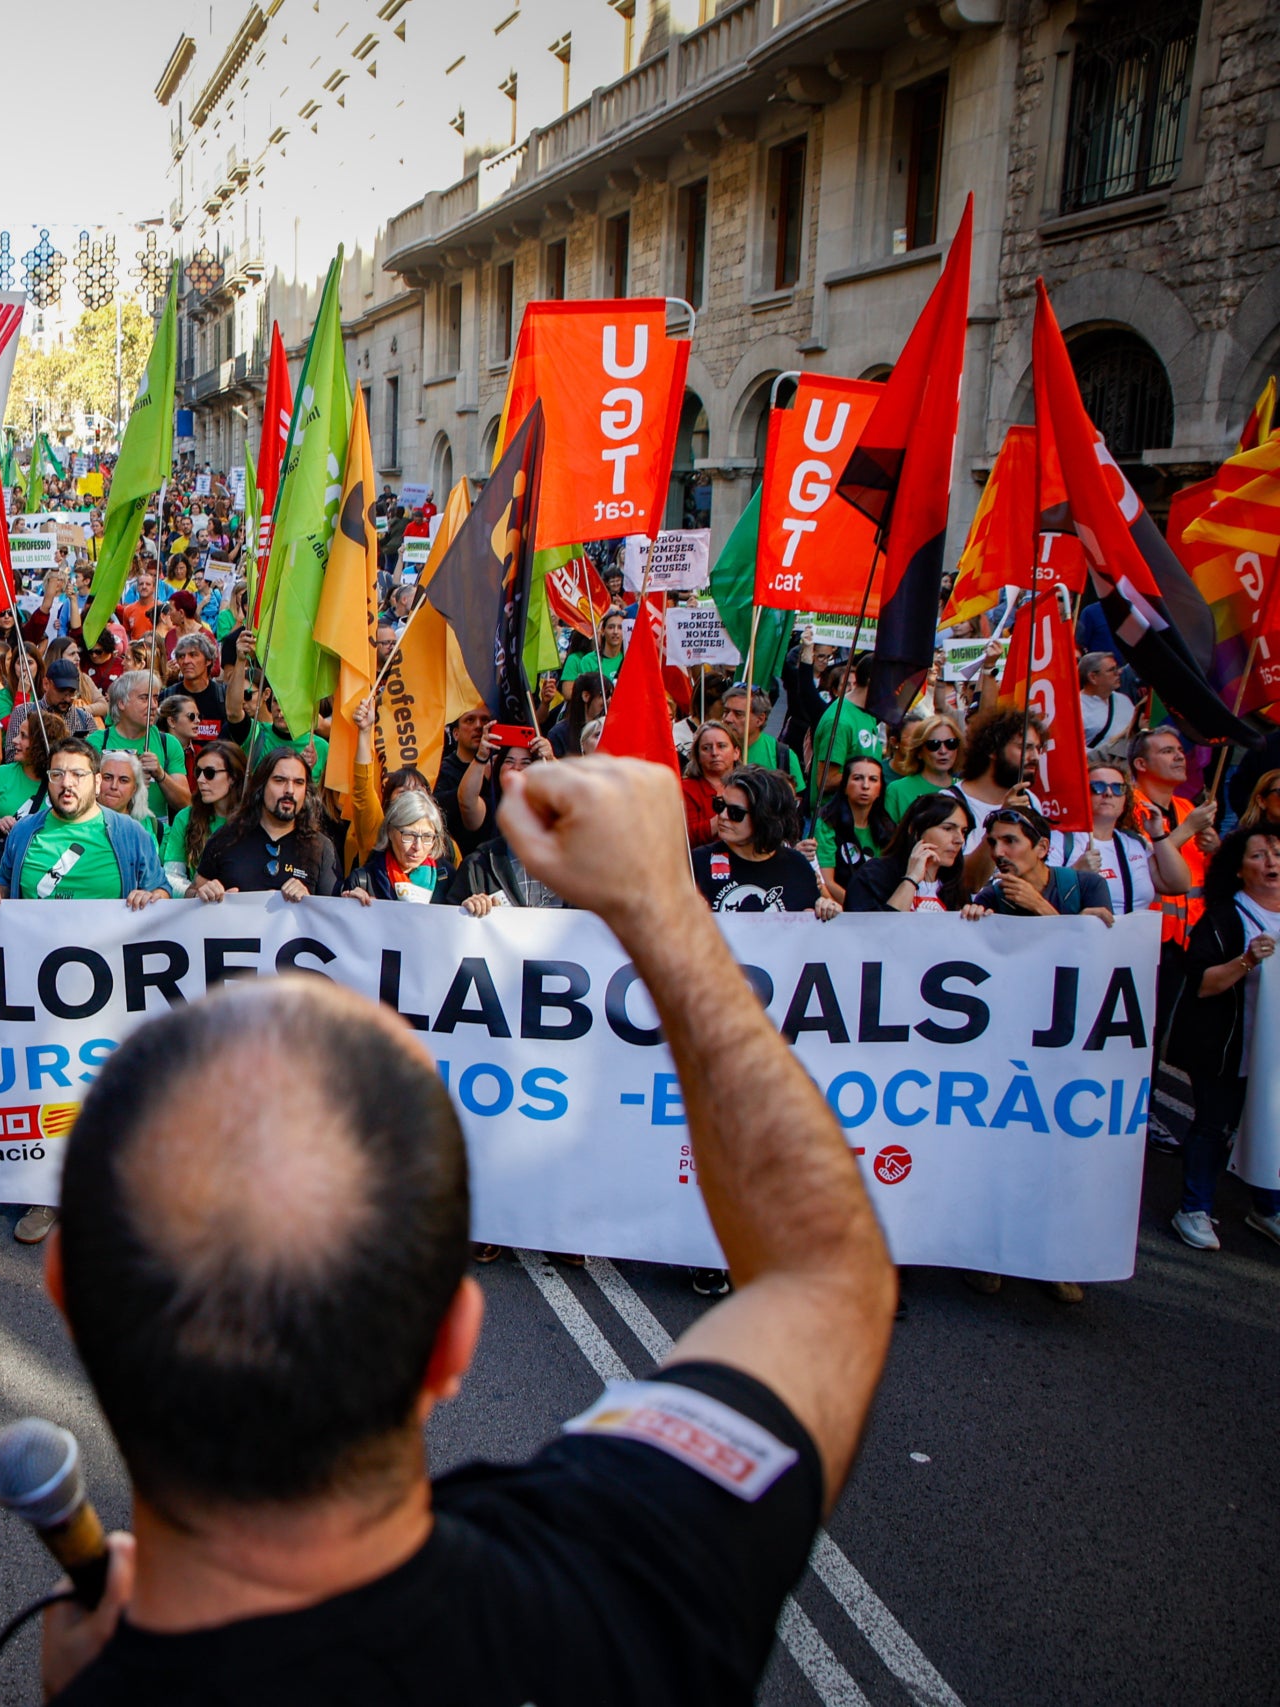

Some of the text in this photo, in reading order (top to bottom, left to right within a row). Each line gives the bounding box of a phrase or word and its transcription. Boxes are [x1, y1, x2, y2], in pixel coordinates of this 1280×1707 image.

[783, 398, 850, 568] UGT
[768, 571, 803, 592] .cat
[711, 872, 730, 880] CGT
[712, 880, 739, 910] LA LUCHA
[1032, 966, 1148, 1051] JA
